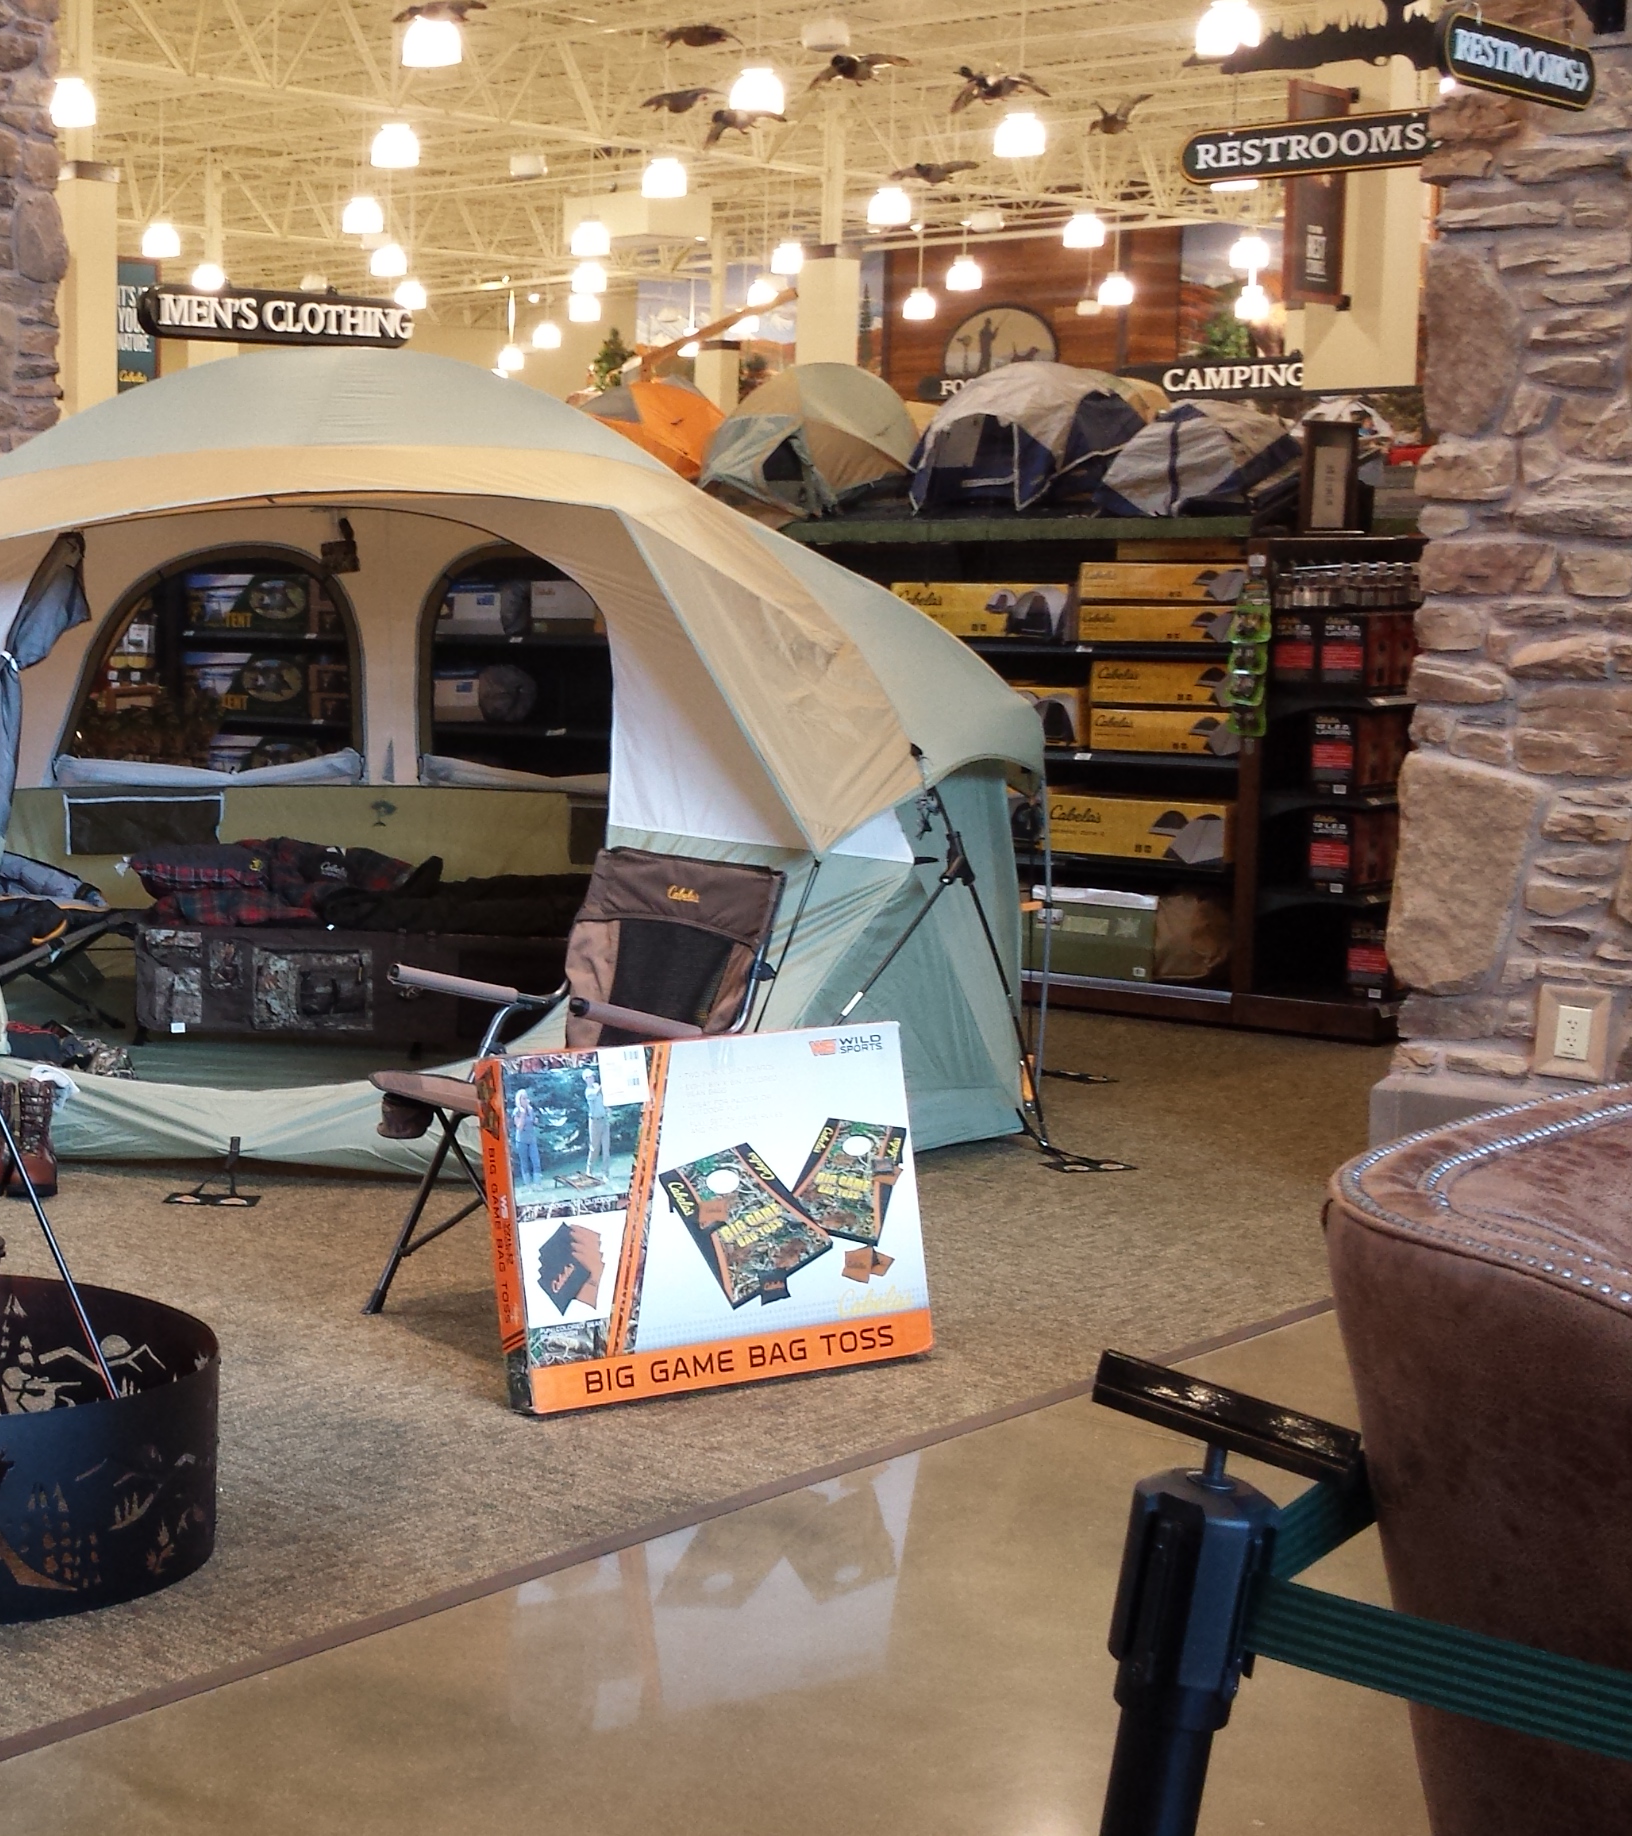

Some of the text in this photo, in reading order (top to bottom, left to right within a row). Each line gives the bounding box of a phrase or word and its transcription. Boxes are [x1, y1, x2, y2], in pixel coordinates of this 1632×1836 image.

[1454, 28, 1575, 86] RESTROOMS
[1195, 122, 1427, 170] RESTROOMS
[158, 294, 415, 339] MEN'S CLOTHING
[1163, 363, 1304, 393] CAMPING
[1050, 804, 1101, 823] Cabela's
[839, 1034, 882, 1045] WILD
[839, 1042, 884, 1054] SPORTS
[489, 1147, 497, 1175] BIG
[491, 1183, 501, 1231] GAME
[668, 1181, 696, 1217] Cabela's
[718, 1202, 783, 1242] BIG GAME
[736, 1218, 784, 1248] BAG TOSS
[496, 1238, 506, 1273] BAG
[500, 1282, 511, 1325] TOSS
[585, 1324, 894, 1394] BIG GAME BAG TOSS
